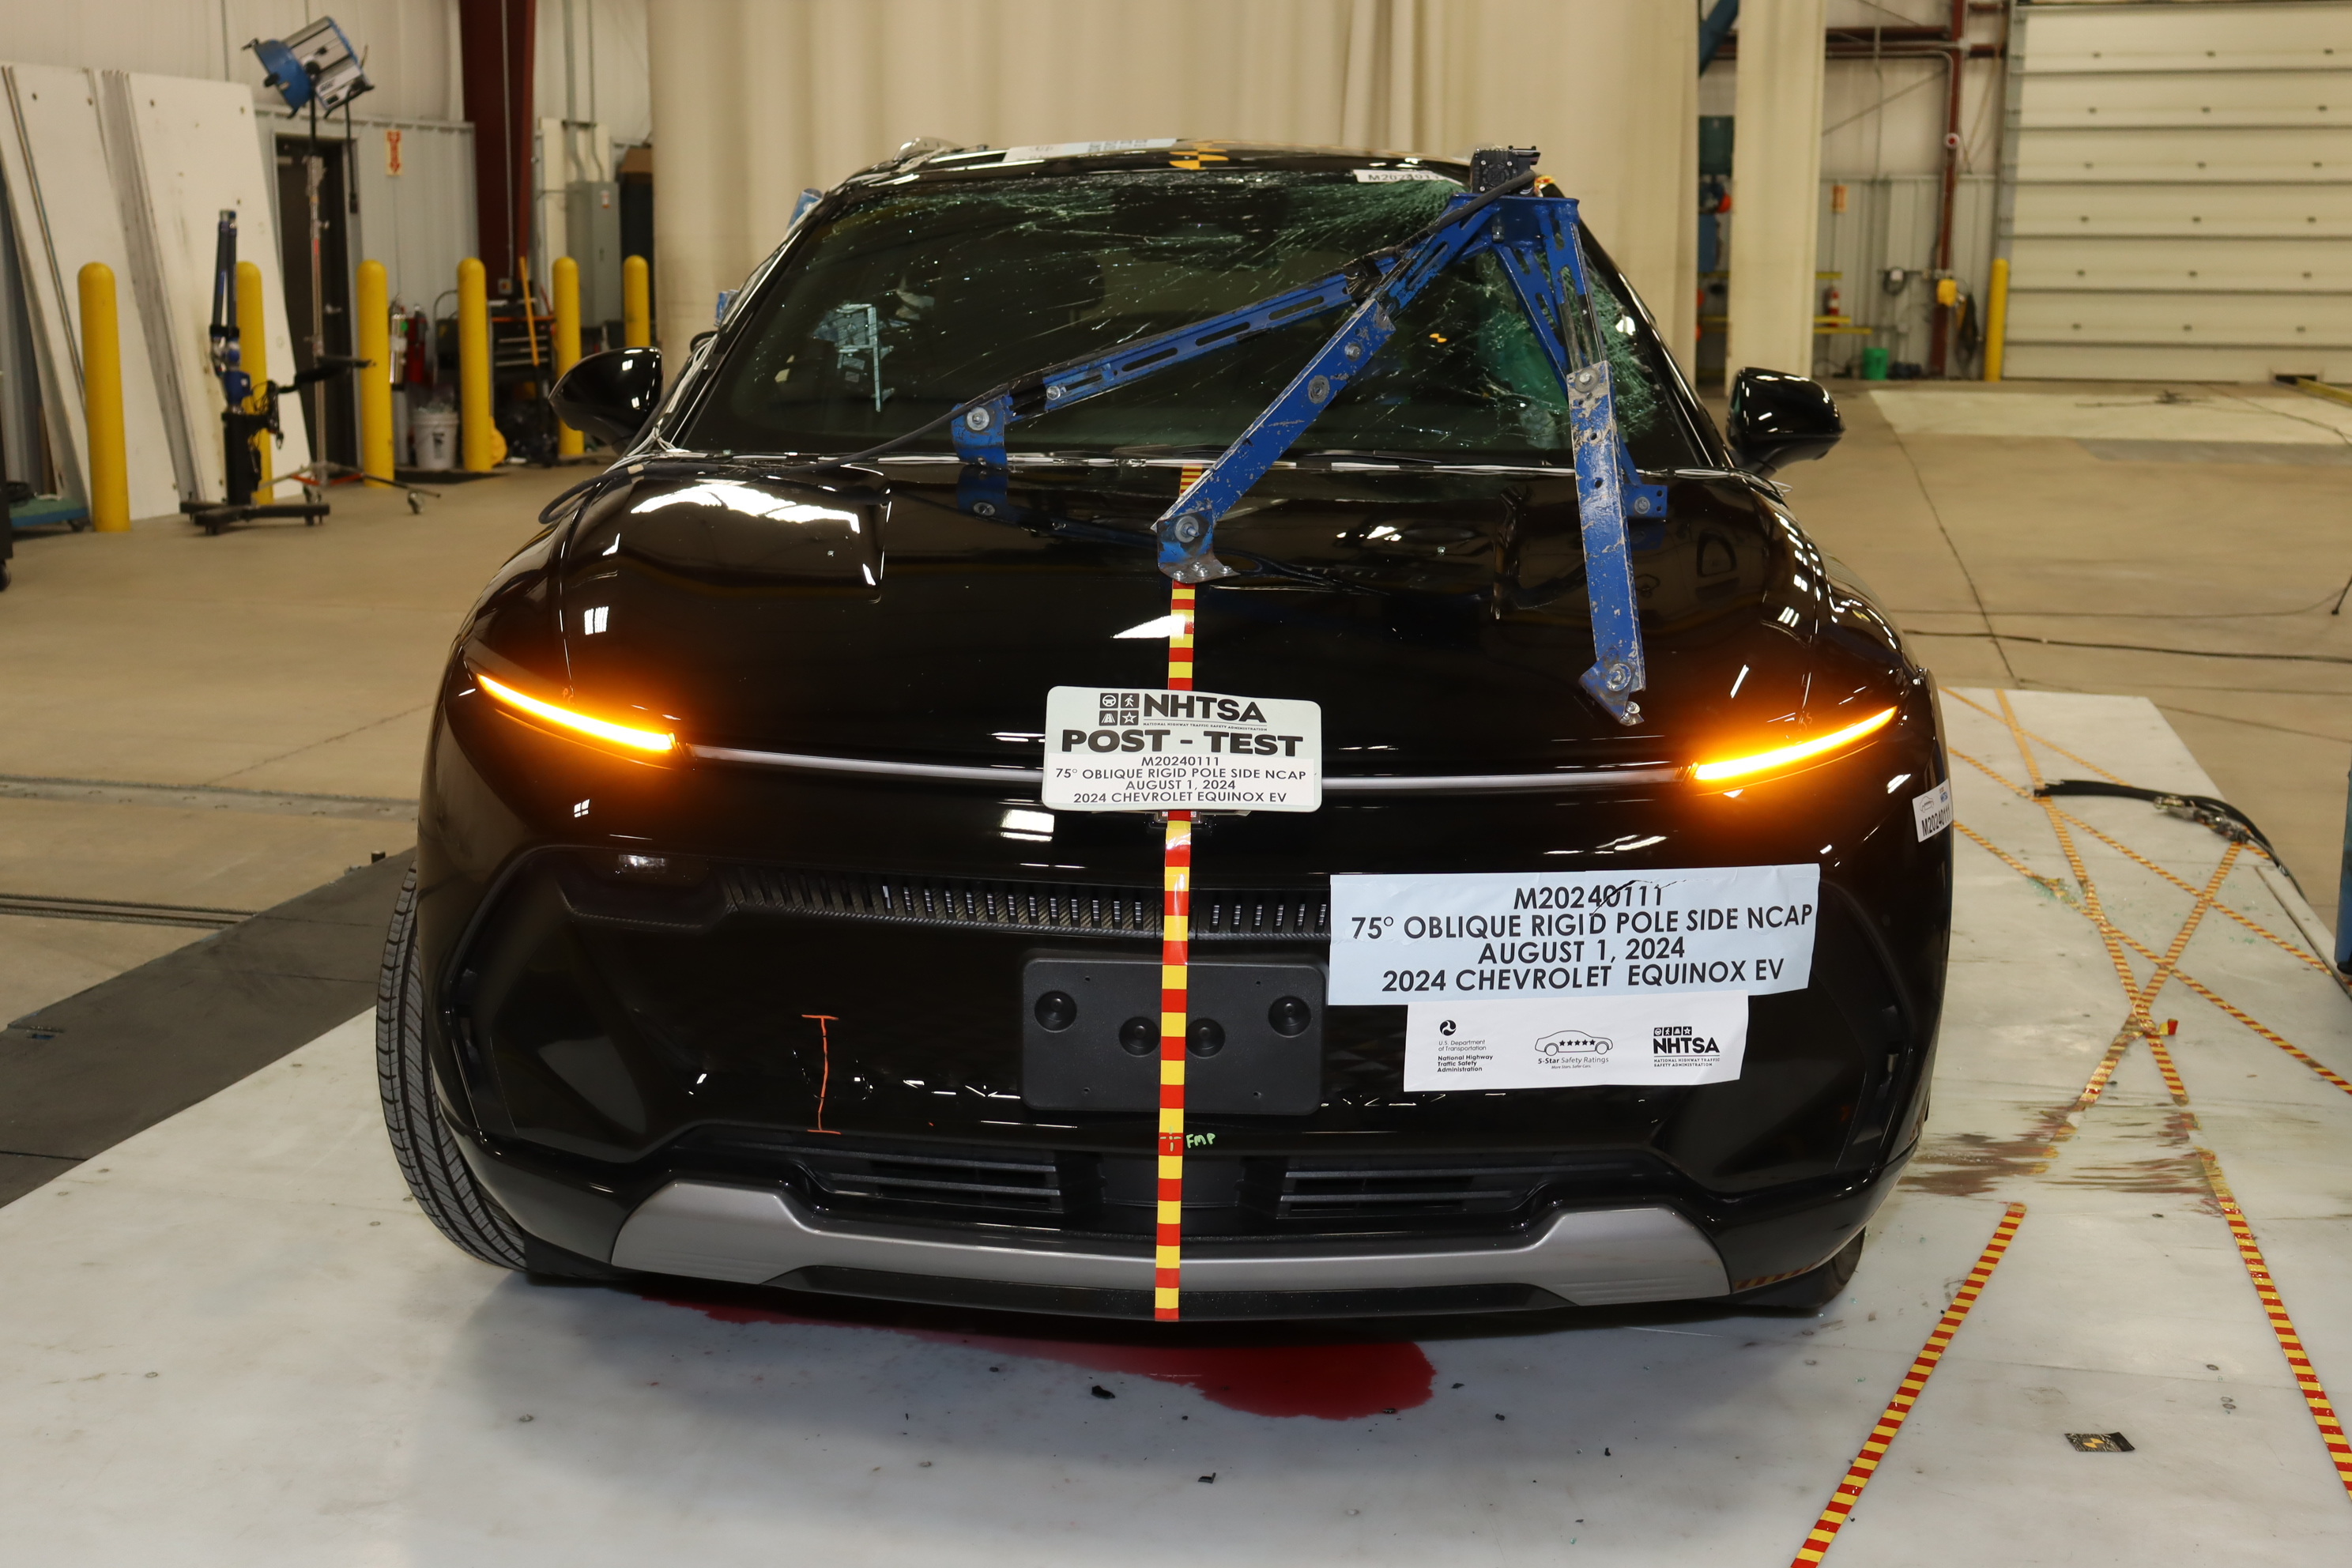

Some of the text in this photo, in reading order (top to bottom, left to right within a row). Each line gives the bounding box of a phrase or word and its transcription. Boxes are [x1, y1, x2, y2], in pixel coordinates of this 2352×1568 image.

[1144, 693, 1268, 723] NHTSA
[1061, 729, 1171, 752] POST
[1203, 730, 1304, 757] TEST
[1141, 756, 1219, 767] M20240111
[1056, 767, 1306, 780] 75° OBLIQUE RIGID POLE SIDE NCAP
[1125, 779, 1236, 791] AUGUST 1, 2024
[1073, 791, 1287, 803] 2024 CHEVROLET EQUINOX EV
[1513, 884, 1662, 910] M20240111
[1351, 903, 1812, 940] 75° OBLIQUE RIGID POLE SIDE NCAP
[1477, 936, 1685, 965] AUGUST 1, 2024
[1381, 958, 1785, 992] 2024 CHEVROLET EQUINOX EV
[1653, 1037, 1720, 1054] NHTSA
[1584, 1056, 1609, 1065] Ratings
[1185, 1133, 1216, 1148] FMP
